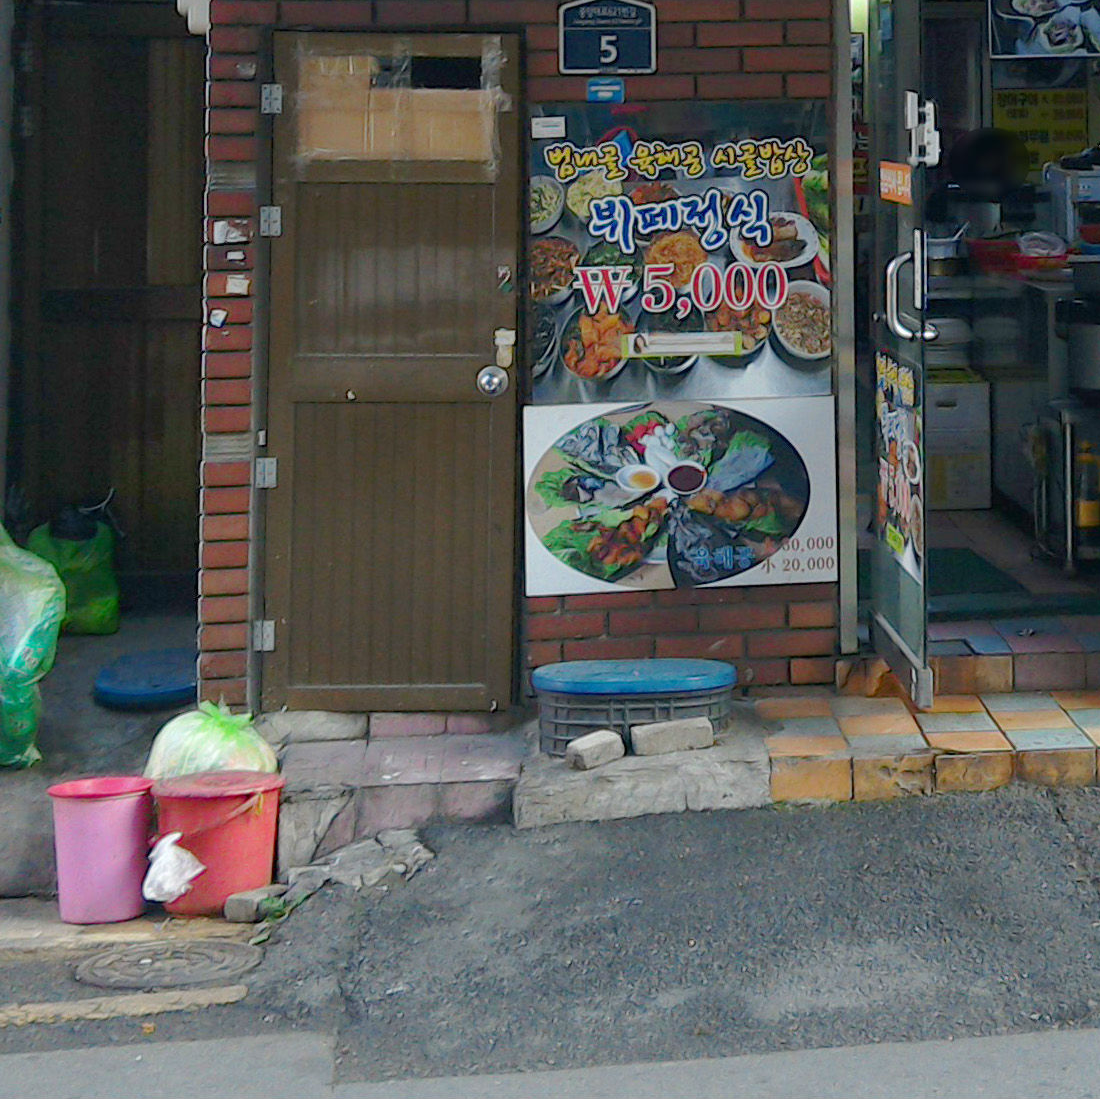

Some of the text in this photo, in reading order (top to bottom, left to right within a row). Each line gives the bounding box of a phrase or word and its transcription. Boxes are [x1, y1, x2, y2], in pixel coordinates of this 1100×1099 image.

[599, 34, 618, 64] 5
[544, 141, 628, 183] 범내골
[711, 138, 813, 181] 시골밥상
[590, 187, 773, 255] 뷔페정식
